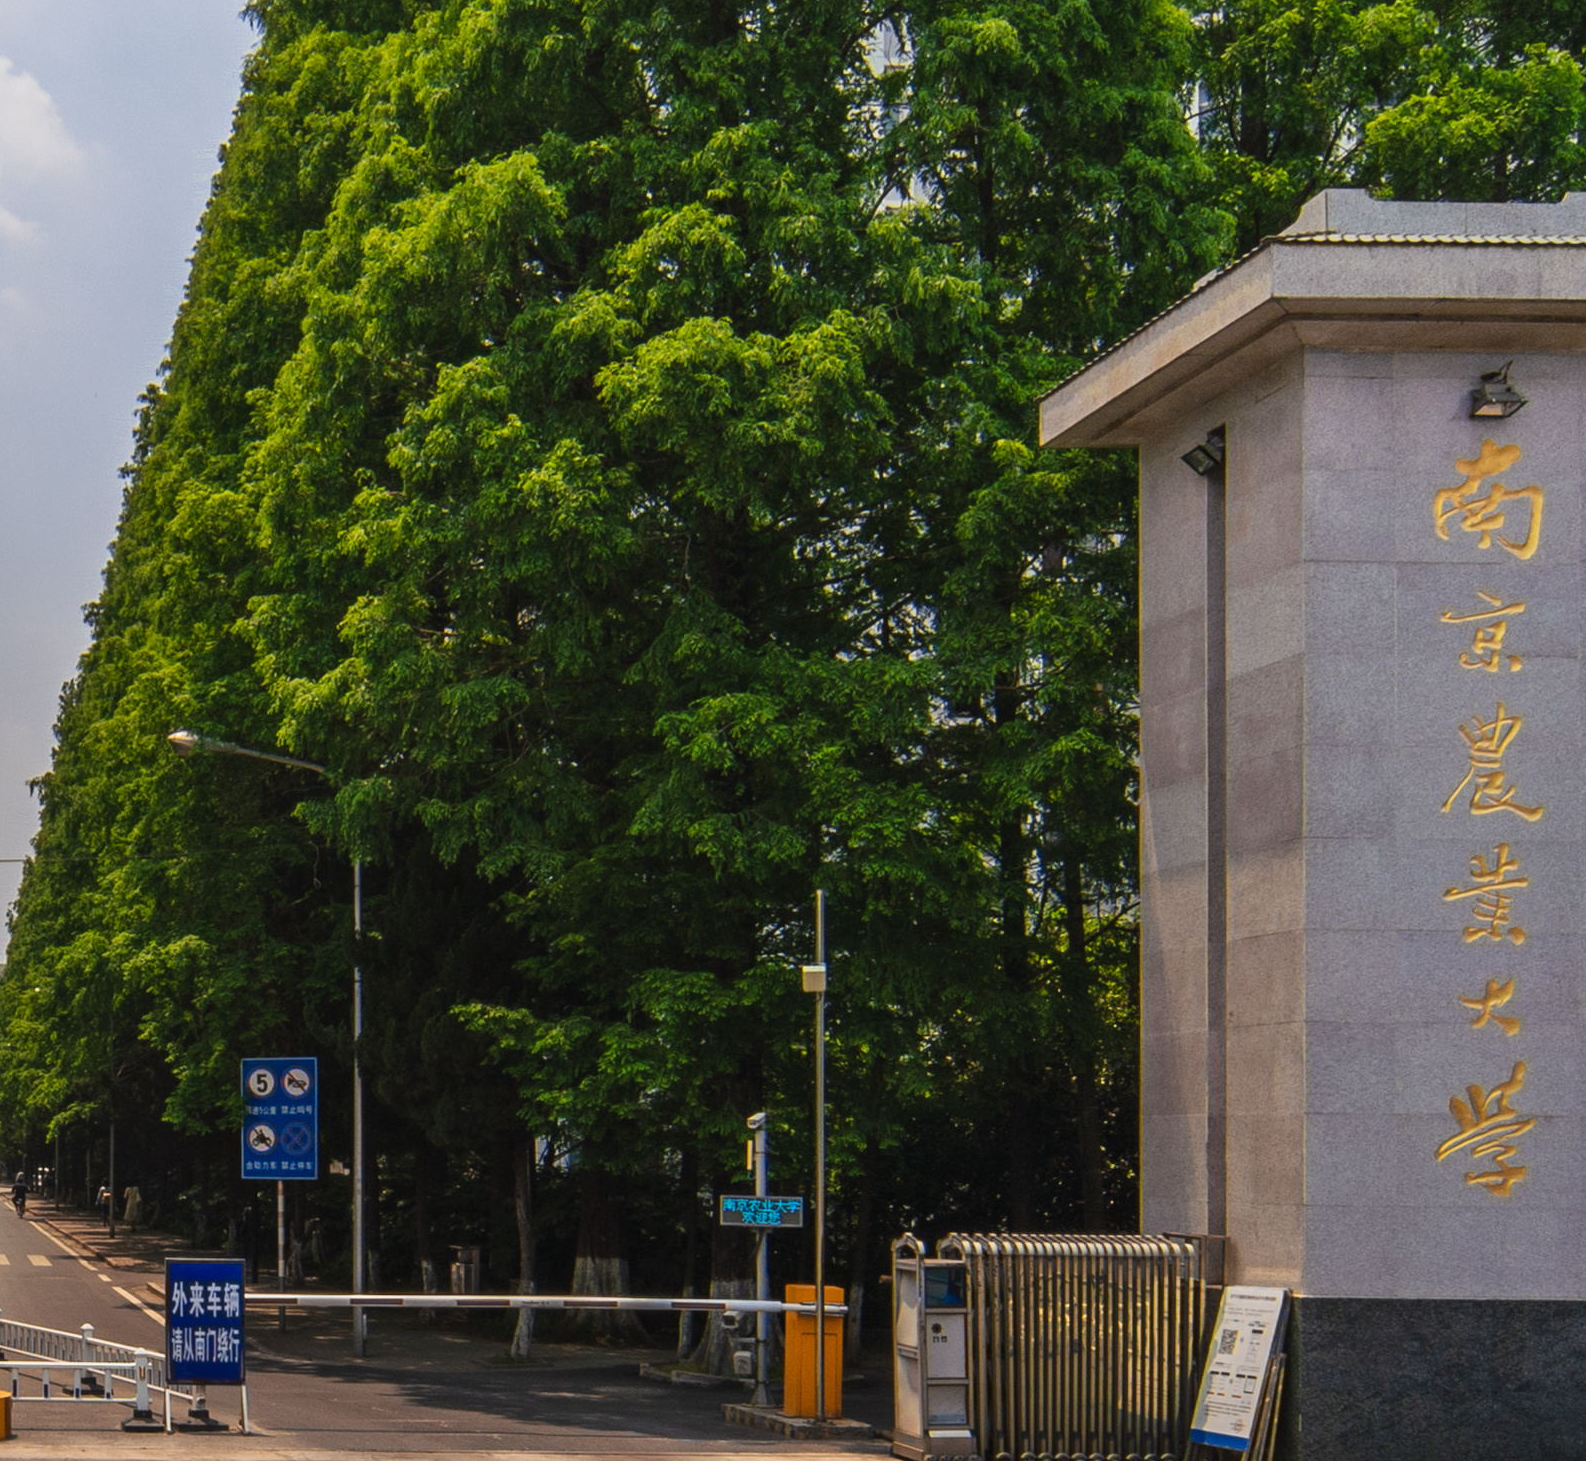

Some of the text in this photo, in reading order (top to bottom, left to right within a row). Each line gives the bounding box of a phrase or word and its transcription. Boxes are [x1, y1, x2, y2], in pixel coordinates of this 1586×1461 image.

[256, 1073, 268, 1093] 5
[723, 1198, 801, 1213] 南京农业大学
[172, 1281, 240, 1318] 外来车辆
[172, 1327, 240, 1363] 请从南门绕行
